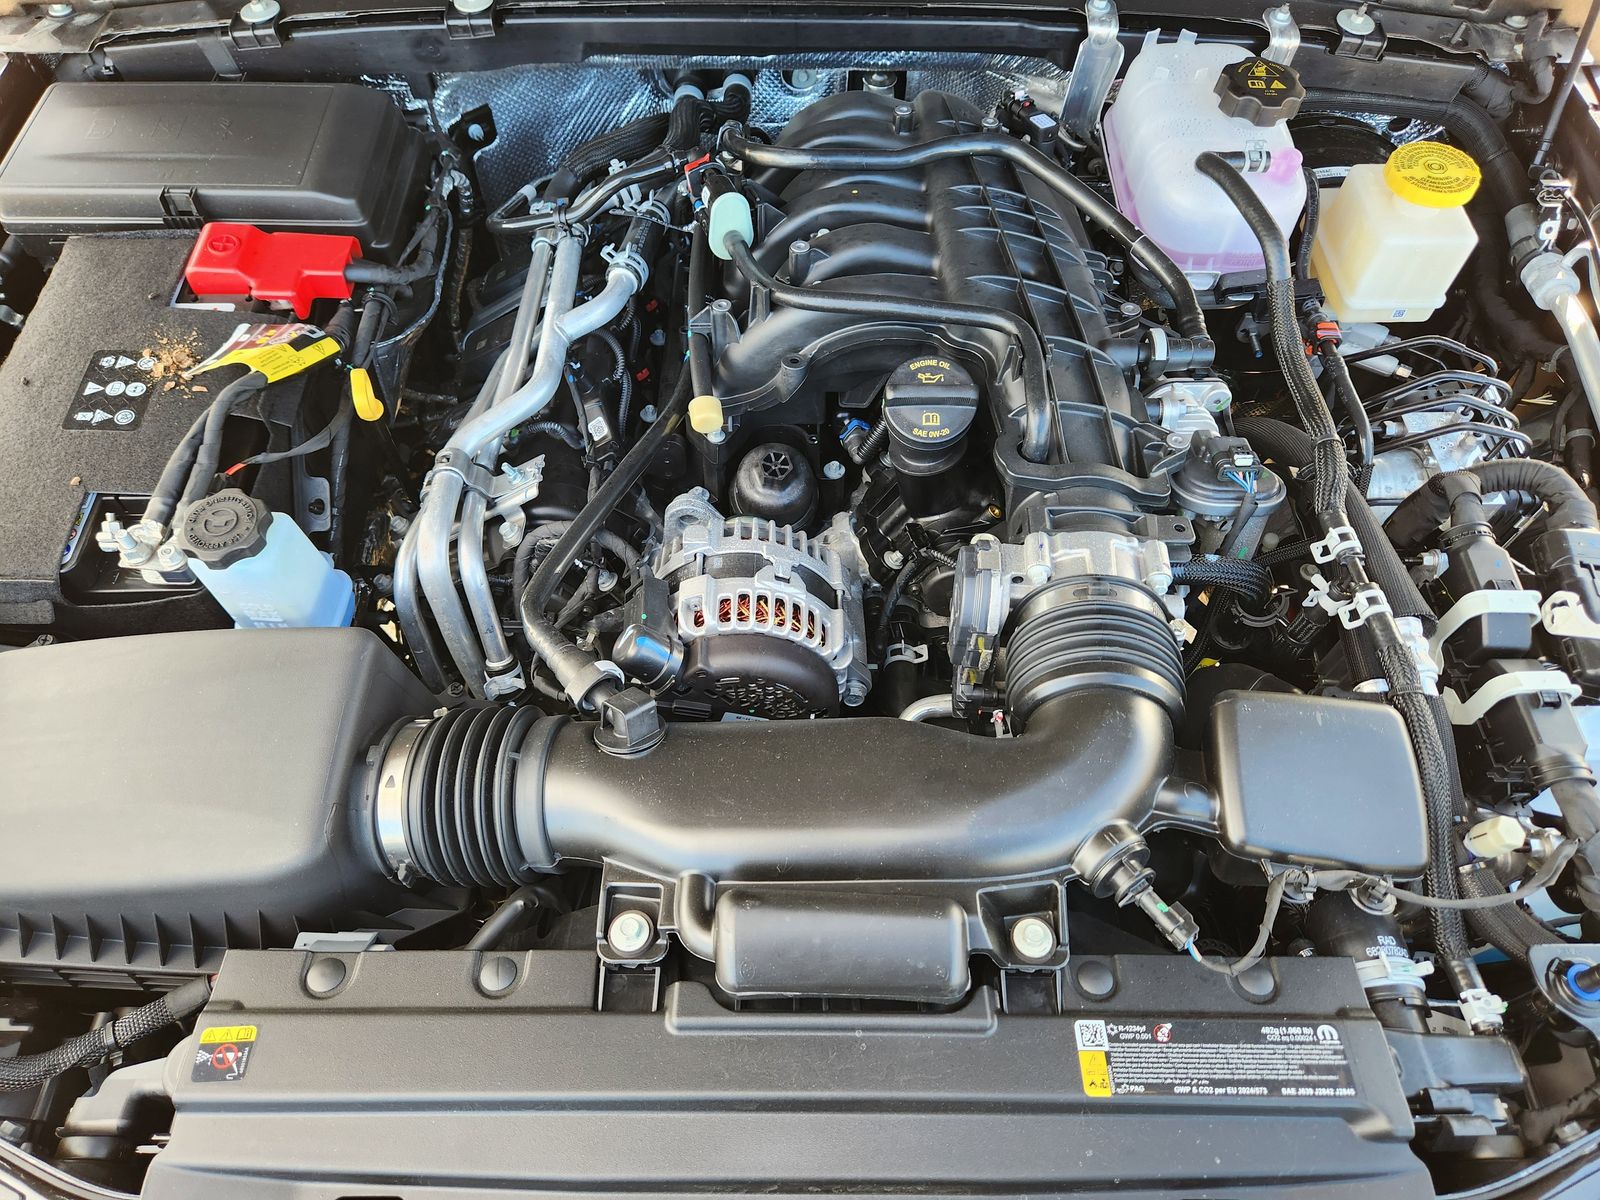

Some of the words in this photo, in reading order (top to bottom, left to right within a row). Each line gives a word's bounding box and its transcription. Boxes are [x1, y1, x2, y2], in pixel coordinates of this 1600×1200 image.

[909, 359, 938, 371] ENGINE
[938, 359, 951, 370] OIL
[912, 427, 928, 438] SAE
[928, 427, 950, 438] 0W-20
[1376, 935, 1396, 946] RAD
[1129, 1085, 1145, 1093] PAG
[1173, 1086, 1191, 1094] GWP
[1199, 1086, 1214, 1094] CO2
